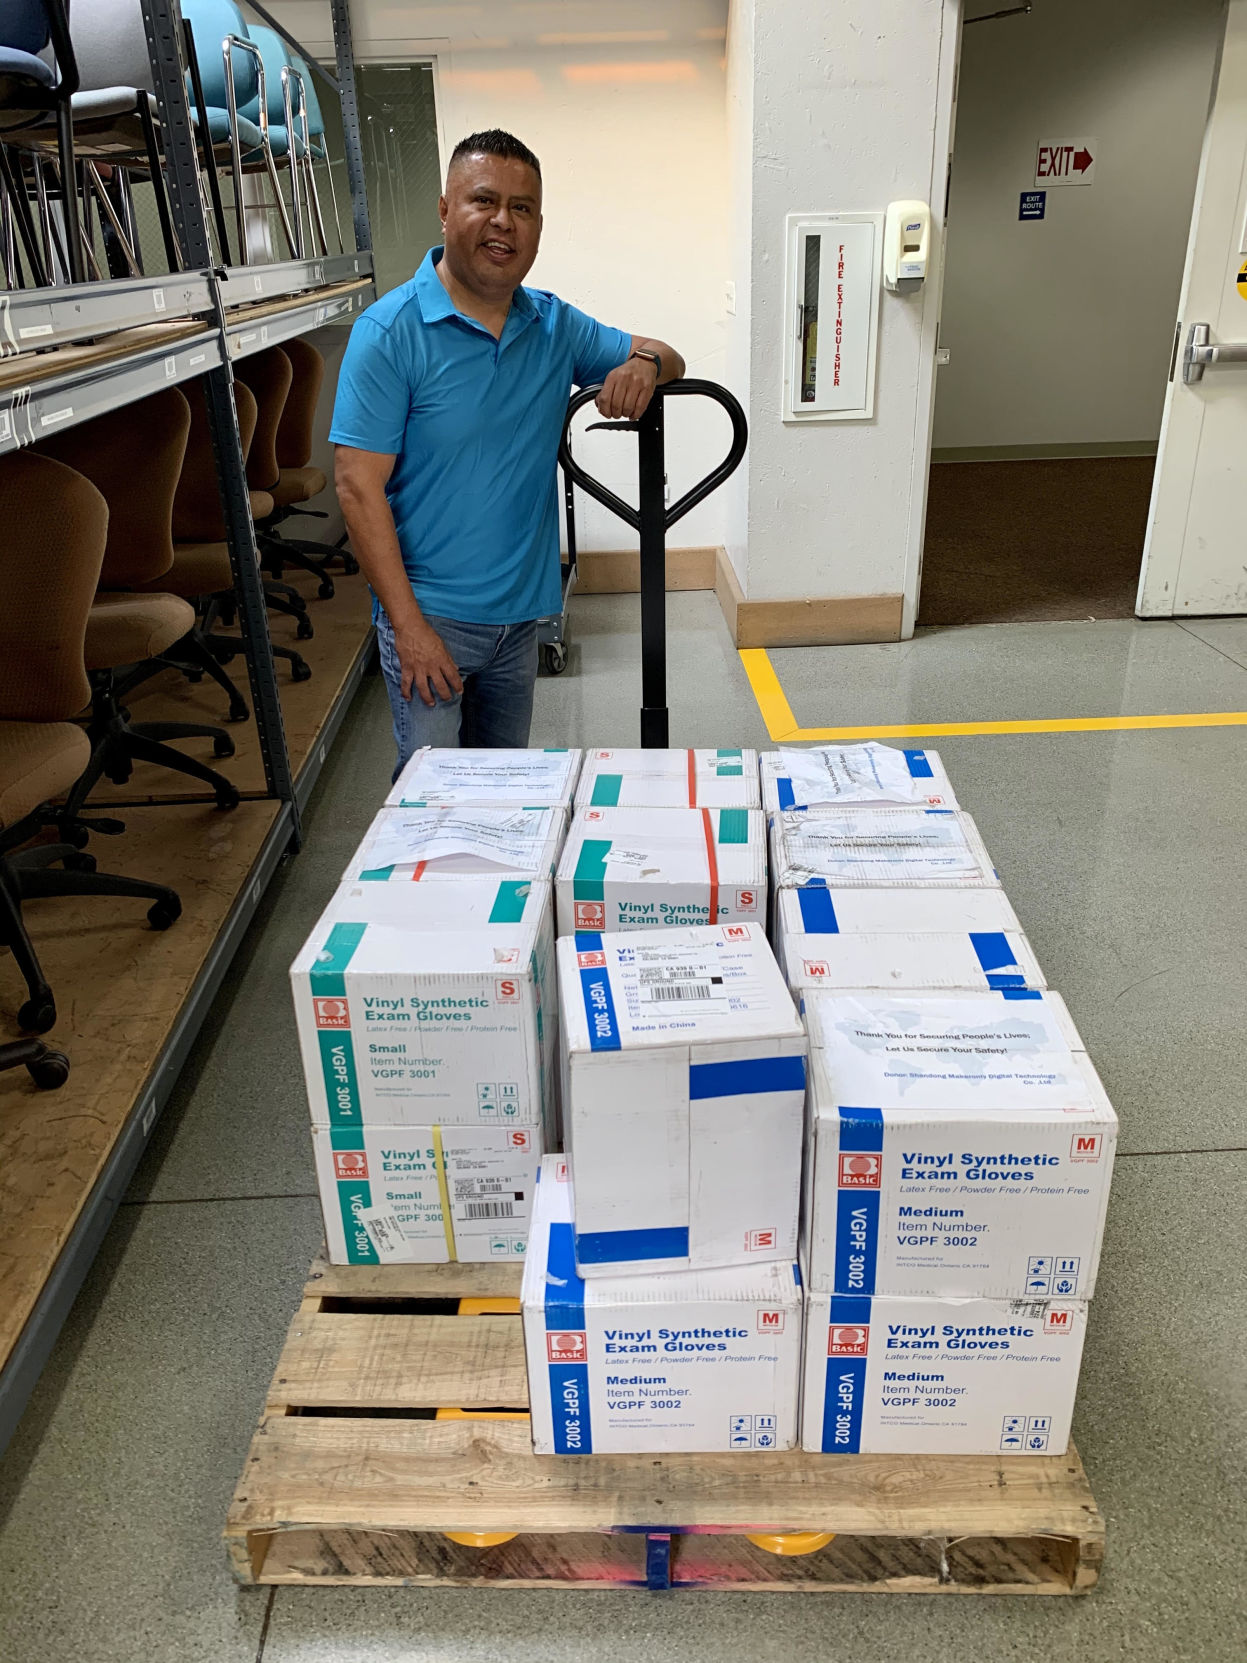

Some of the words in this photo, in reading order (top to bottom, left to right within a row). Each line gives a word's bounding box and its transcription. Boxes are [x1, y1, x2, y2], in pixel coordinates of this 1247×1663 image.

[1037, 146, 1074, 177] EXIT
[837, 245, 845, 279] FIRE
[833, 284, 844, 386] EXTINGUISHER
[589, 811, 601, 819] S
[618, 902, 654, 914] Vinyl
[660, 903, 730, 915] Syntheic
[741, 892, 754, 904] S
[618, 914, 658, 924] Exam
[727, 927, 744, 937] M
[810, 967, 825, 975] M
[501, 981, 515, 996] S
[589, 981, 607, 1010] VGPF
[363, 997, 404, 1009] Vinyl
[411, 997, 489, 1010] Synthetic
[365, 1010, 411, 1021] Exam
[416, 1010, 472, 1021] Gloves
[594, 1011, 612, 1038] 3002
[855, 1030, 883, 1038] Thank
[369, 1044, 407, 1053] Small
[330, 1045, 349, 1083] VGPF
[370, 1057, 395, 1066] Item
[371, 1069, 405, 1078] VGPF
[409, 1069, 436, 1078] 3001
[336, 1086, 353, 1116] 3001
[512, 1132, 526, 1145] S
[1077, 1137, 1096, 1150] M
[380, 1149, 420, 1161] Vinyl
[902, 1152, 953, 1166] Vinyl
[960, 1153, 1060, 1167] Synthetic
[382, 1162, 426, 1171] Exam
[901, 1167, 958, 1180] Exam
[966, 1168, 1035, 1181] Gloves
[386, 1191, 422, 1200] Small
[899, 1185, 926, 1193] Latex
[928, 1185, 951, 1193] Free
[959, 1185, 997, 1193] Powder
[999, 1186, 1021, 1194] Free
[1029, 1186, 1065, 1195] Protein
[1067, 1187, 1090, 1195] Free
[898, 1206, 964, 1217] Medium
[396, 1214, 421, 1222] GPF
[424, 1214, 444, 1222] 300
[850, 1207, 867, 1251] VGPF
[898, 1221, 928, 1231] Item
[354, 1230, 371, 1256] 3001
[758, 1232, 772, 1246] M
[897, 1235, 939, 1246] VGPF
[943, 1236, 978, 1246] 3002
[848, 1254, 865, 1289] 3002
[762, 1312, 779, 1324] M
[1050, 1312, 1068, 1324] M
[604, 1329, 651, 1342] Vinyl
[658, 1327, 749, 1341] Synthetic
[888, 1325, 936, 1338] Vinyl
[942, 1325, 1034, 1339] Synthetic
[605, 1343, 657, 1353] Exam
[664, 1341, 727, 1352] Gloves
[886, 1338, 940, 1349] Exam
[946, 1338, 1010, 1349] Gloves
[605, 1357, 629, 1365] Latex
[724, 1354, 756, 1362] Protein
[758, 1354, 779, 1362] Free
[885, 1353, 910, 1361] Latex
[912, 1353, 933, 1361] Free
[940, 1353, 975, 1361] Powder
[1005, 1354, 1038, 1362] Protein
[606, 1375, 667, 1385] Medium
[883, 1372, 945, 1382] Medium
[607, 1388, 635, 1398] Item
[837, 1373, 855, 1411] VGPF
[883, 1385, 910, 1394] Item
[562, 1378, 580, 1416] VGPF
[881, 1397, 920, 1407] VGPF
[924, 1398, 957, 1407] 3002
[607, 1400, 646, 1410] VGPF
[650, 1400, 682, 1409] 3002
[565, 1419, 582, 1448] 3002
[834, 1413, 851, 1444] 3002
